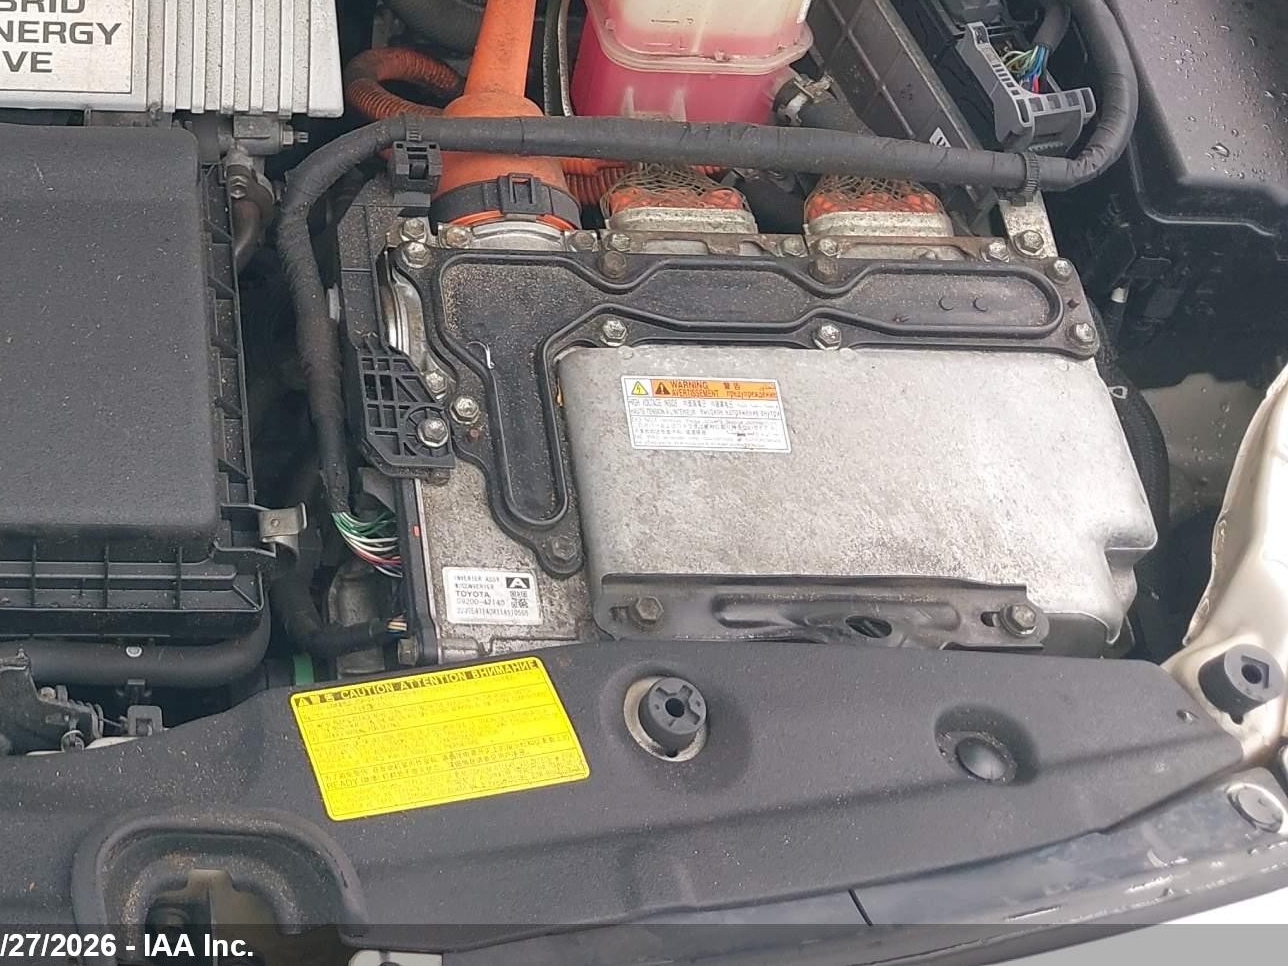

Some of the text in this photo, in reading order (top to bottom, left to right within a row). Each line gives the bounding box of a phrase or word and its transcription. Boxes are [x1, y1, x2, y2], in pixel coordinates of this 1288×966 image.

[670, 381, 709, 390] WARNING
[672, 389, 719, 398] AVERTISSEMENT
[456, 590, 490, 598] TOYOTA
[472, 661, 539, 680] ВНИМАНИЕ
[340, 683, 394, 700] CAUTION
[400, 672, 467, 691] ATTENTION
